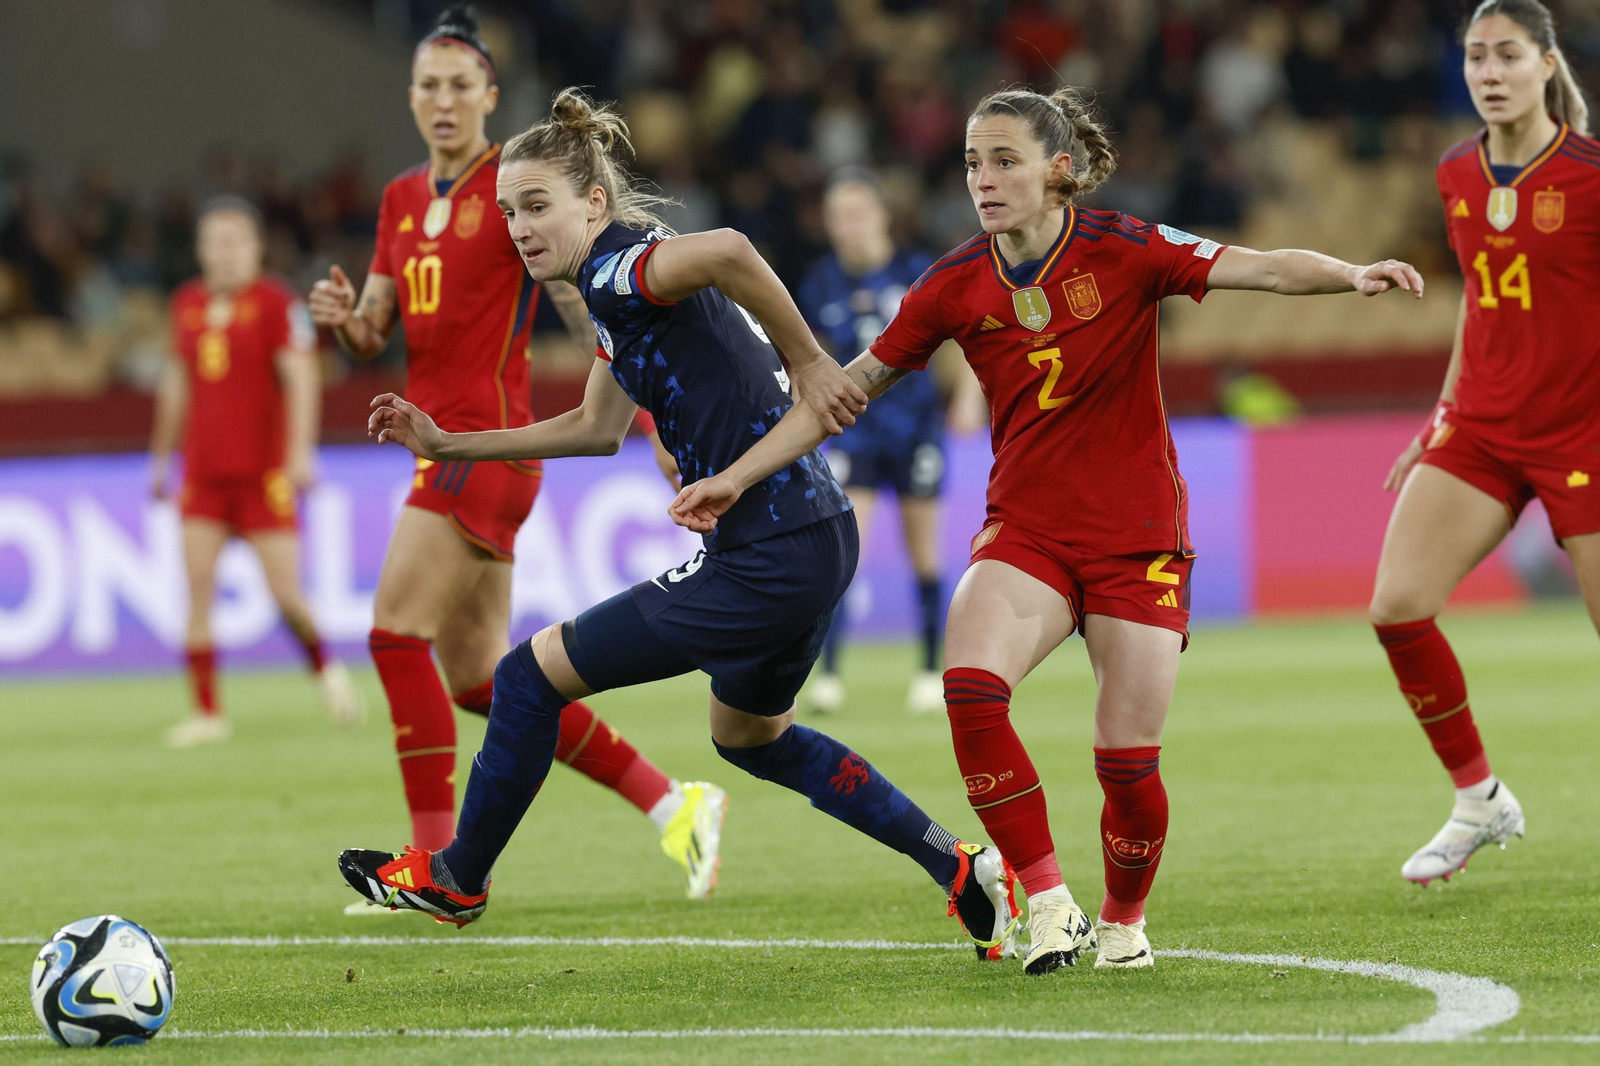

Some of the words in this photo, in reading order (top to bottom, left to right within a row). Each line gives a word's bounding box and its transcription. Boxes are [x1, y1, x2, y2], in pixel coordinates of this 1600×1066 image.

[402, 255, 443, 316] 10
[1472, 251, 1532, 311] 14
[1027, 314, 1043, 322] FIFA
[1027, 348, 1072, 410] 2
